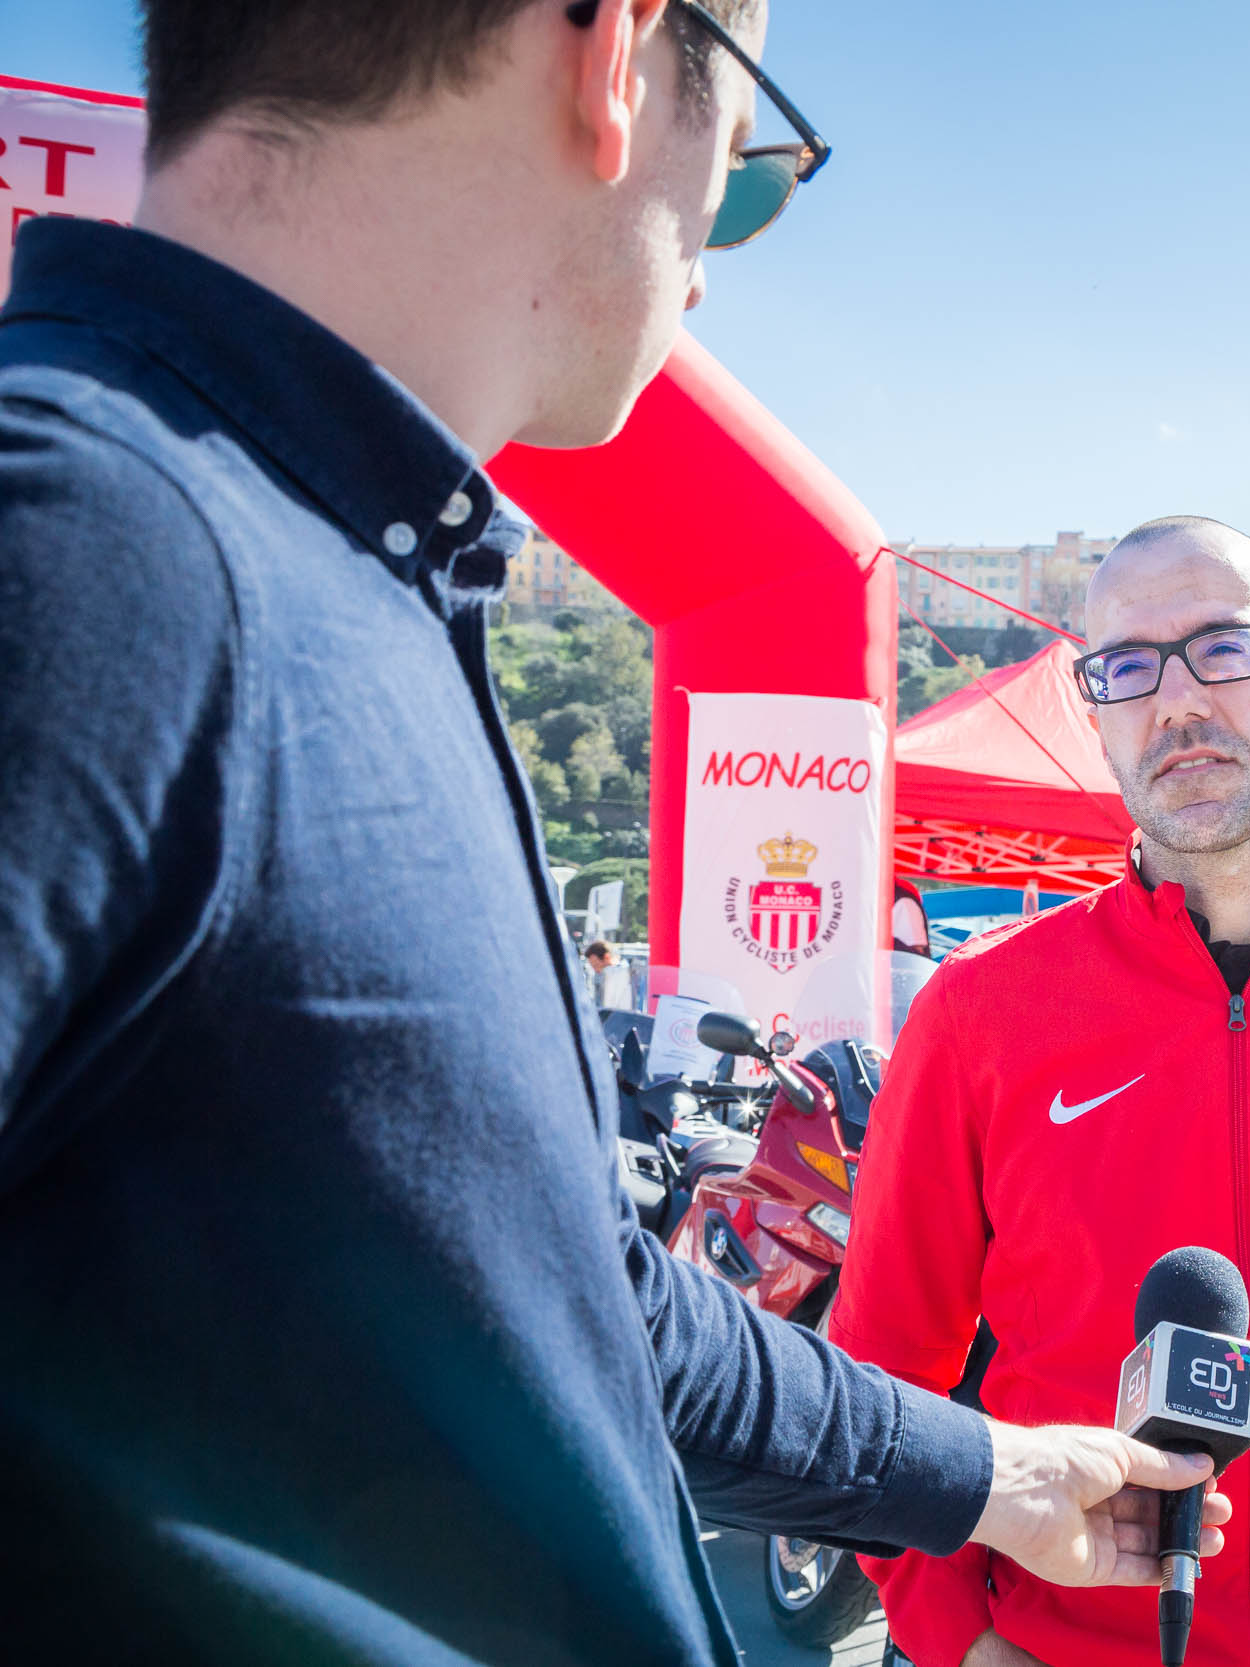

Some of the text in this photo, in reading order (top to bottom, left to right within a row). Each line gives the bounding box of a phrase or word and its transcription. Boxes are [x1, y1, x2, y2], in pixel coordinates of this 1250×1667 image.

[703, 751, 871, 793] MONACO
[759, 895, 813, 906] MONACO
[774, 885, 799, 896] U.C.
[724, 876, 842, 964] UNION CYCLISTE DE MONACO
[1189, 1357, 1238, 1410] EDJ
[1194, 1407, 1203, 1416] DU
